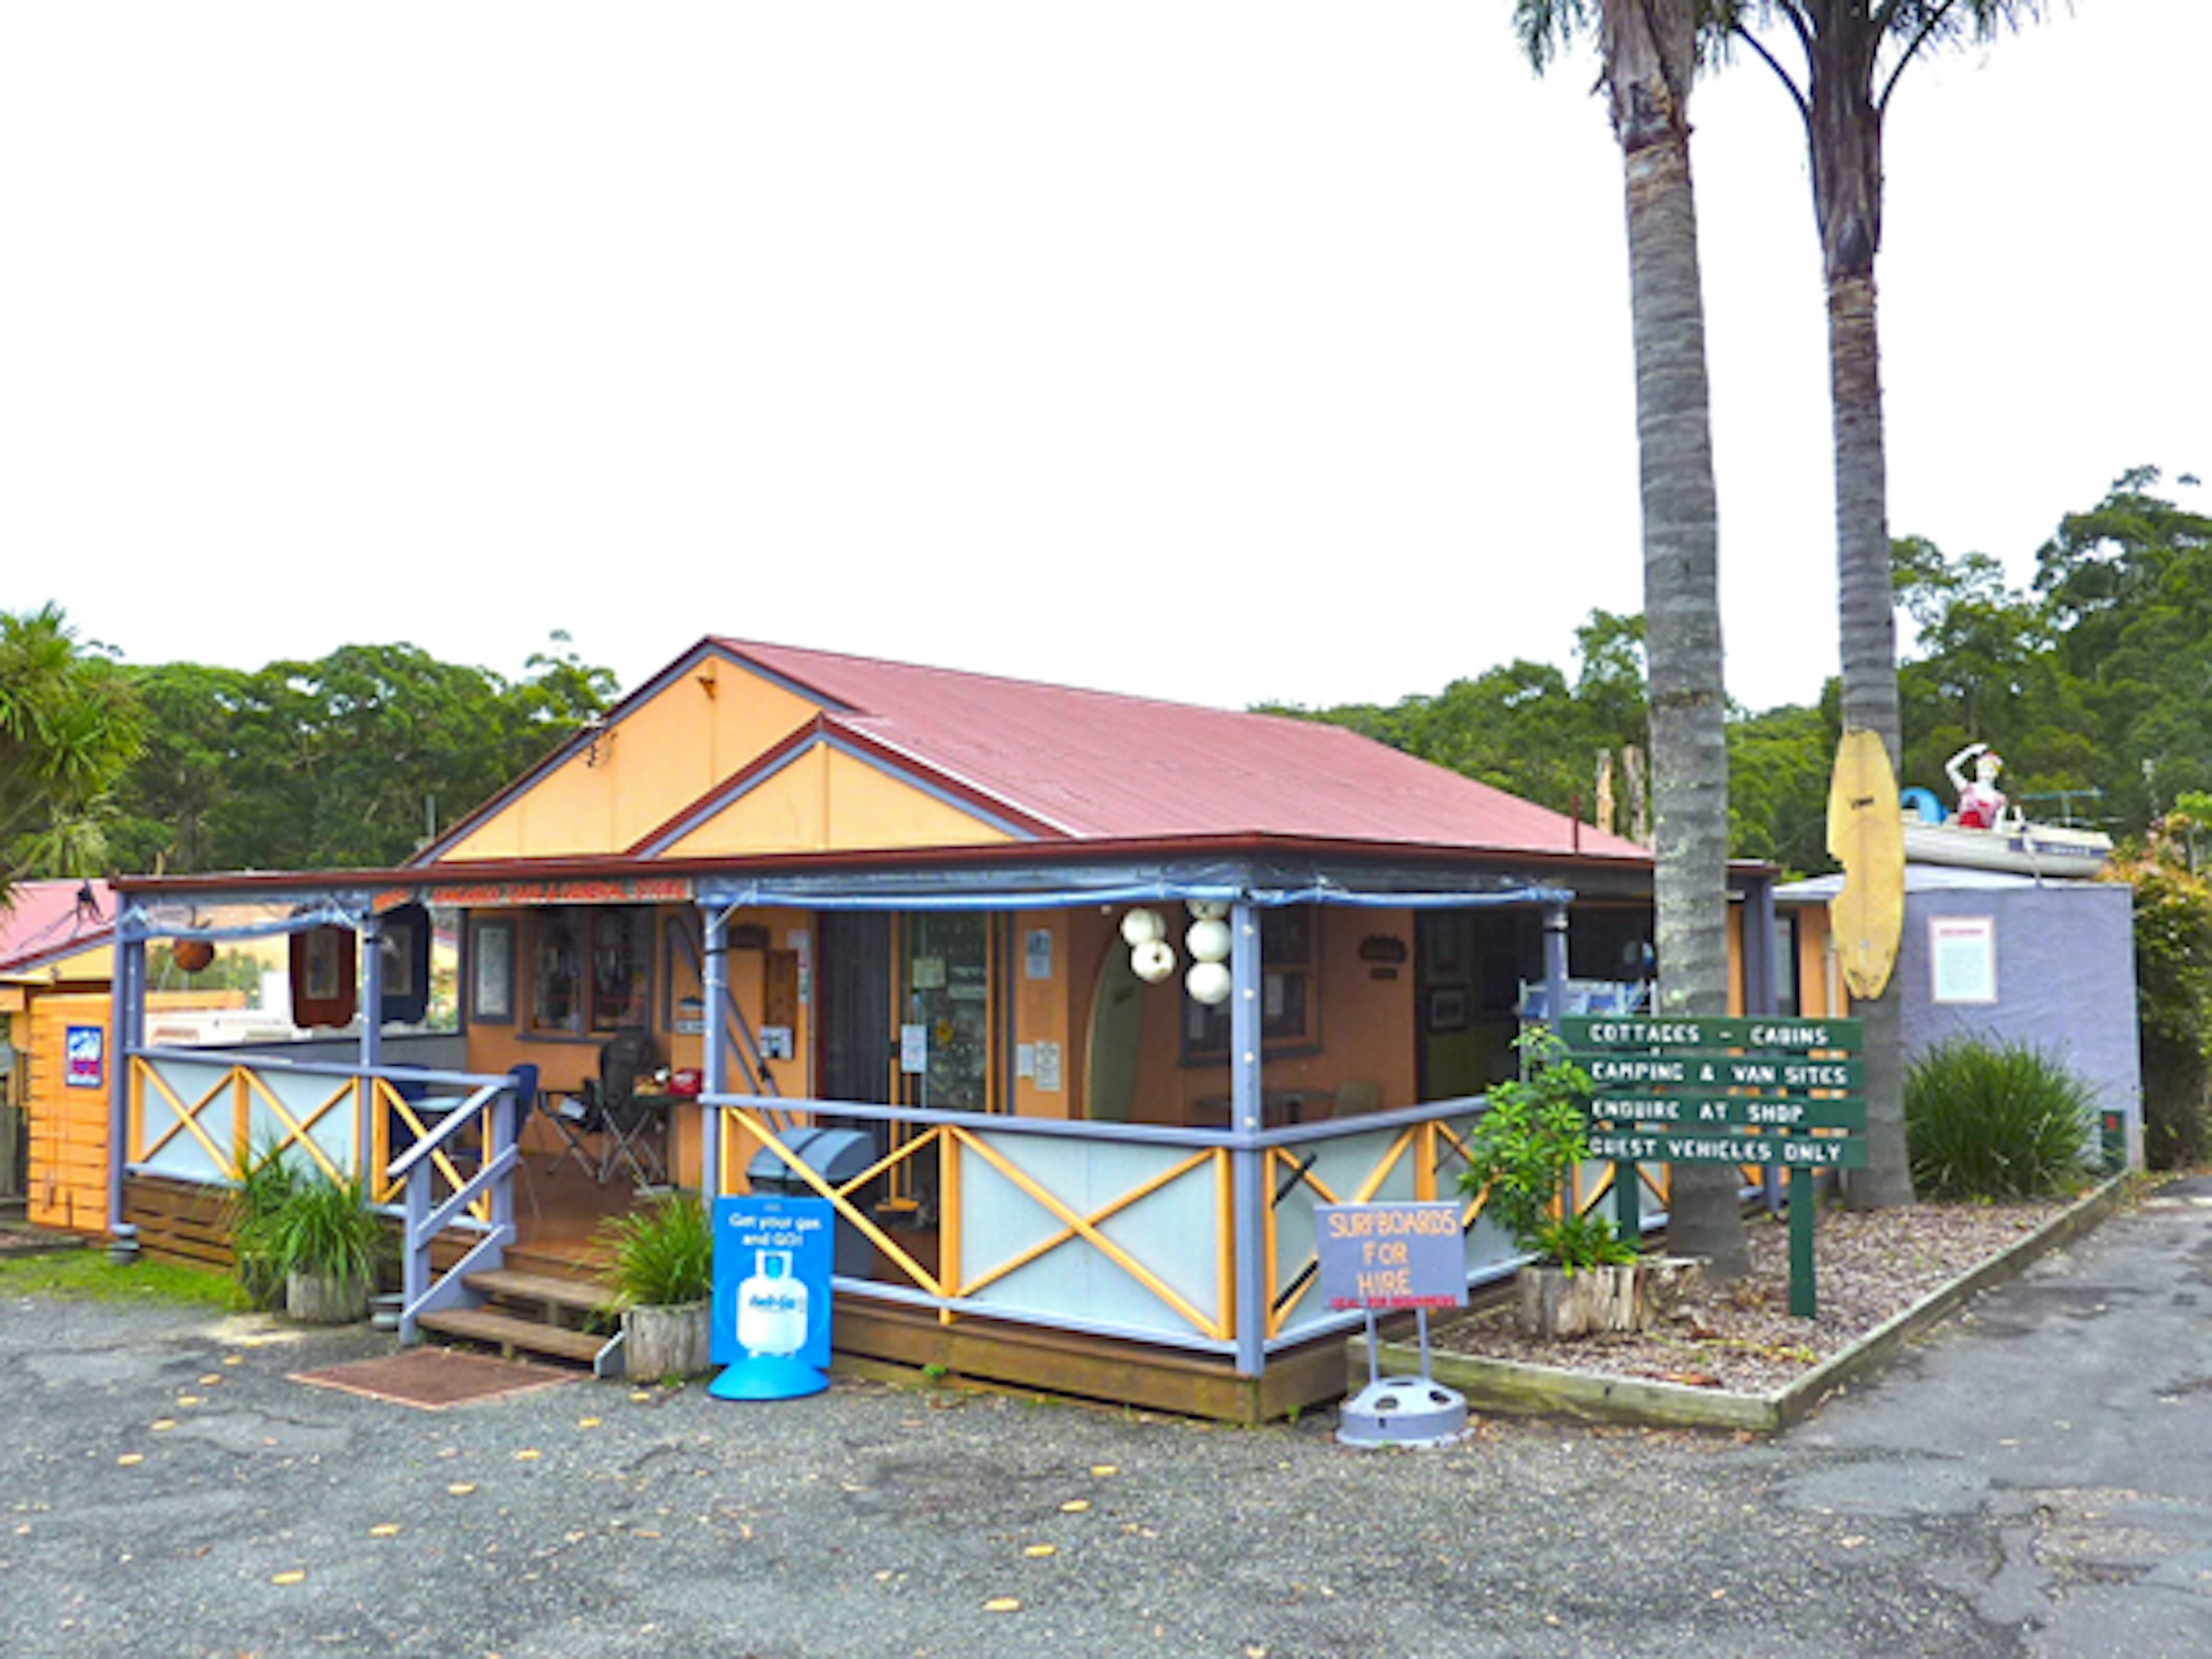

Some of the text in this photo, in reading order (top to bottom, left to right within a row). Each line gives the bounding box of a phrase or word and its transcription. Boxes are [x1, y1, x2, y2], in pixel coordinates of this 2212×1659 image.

[1589, 1024, 1700, 1043] COTTAGES
[1749, 1024, 1830, 1046] CABINS
[1591, 1062, 1848, 1085] CAMPING & VAN SITES
[1590, 1099, 1804, 1123] ENQUIRE AT SHOP
[1589, 1137, 1842, 1162] GUEST VEHICLES ONLY
[1328, 1209, 1458, 1238] SURFBOARDS
[1362, 1241, 1409, 1266] FOR
[1357, 1268, 1412, 1297] HIRE
